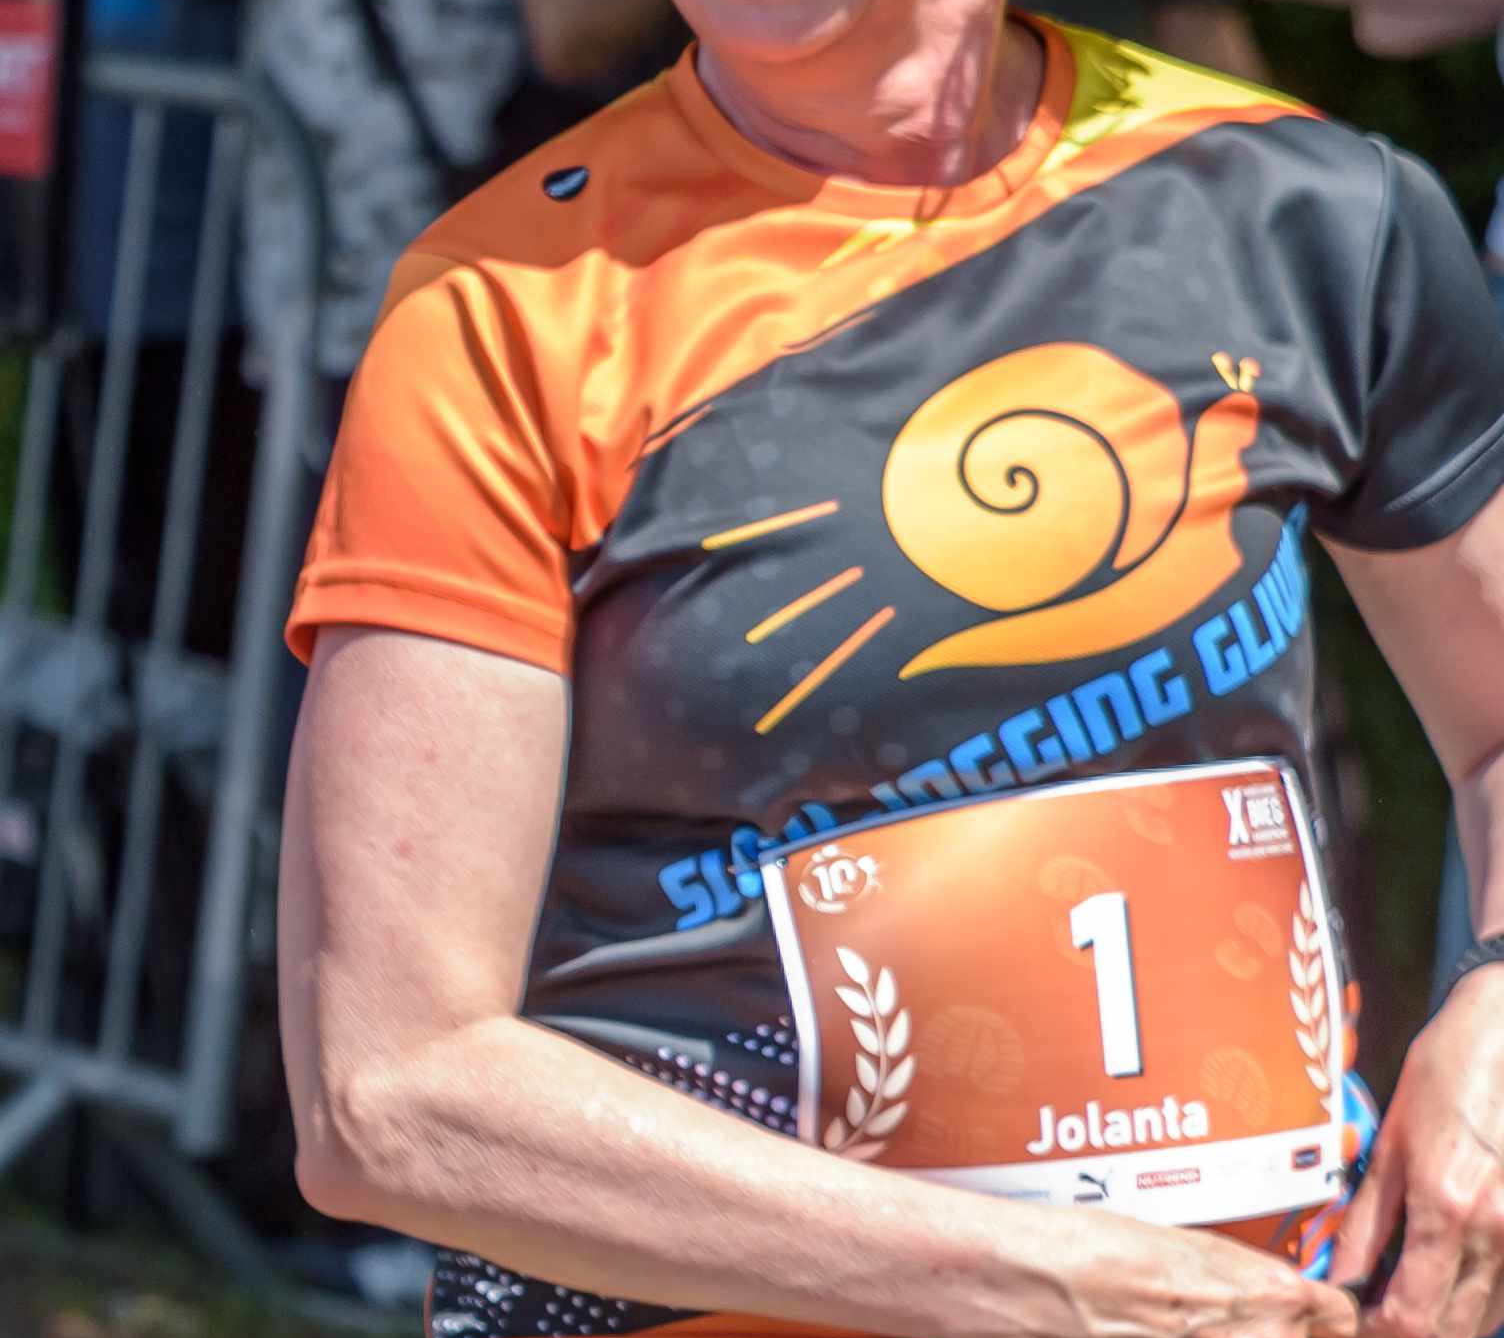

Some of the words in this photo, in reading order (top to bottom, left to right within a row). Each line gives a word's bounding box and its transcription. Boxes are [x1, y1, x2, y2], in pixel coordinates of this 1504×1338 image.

[1221, 788, 1250, 846] X
[1069, 891, 1145, 1080] 1
[1026, 1098, 1209, 1154] Jolanta
